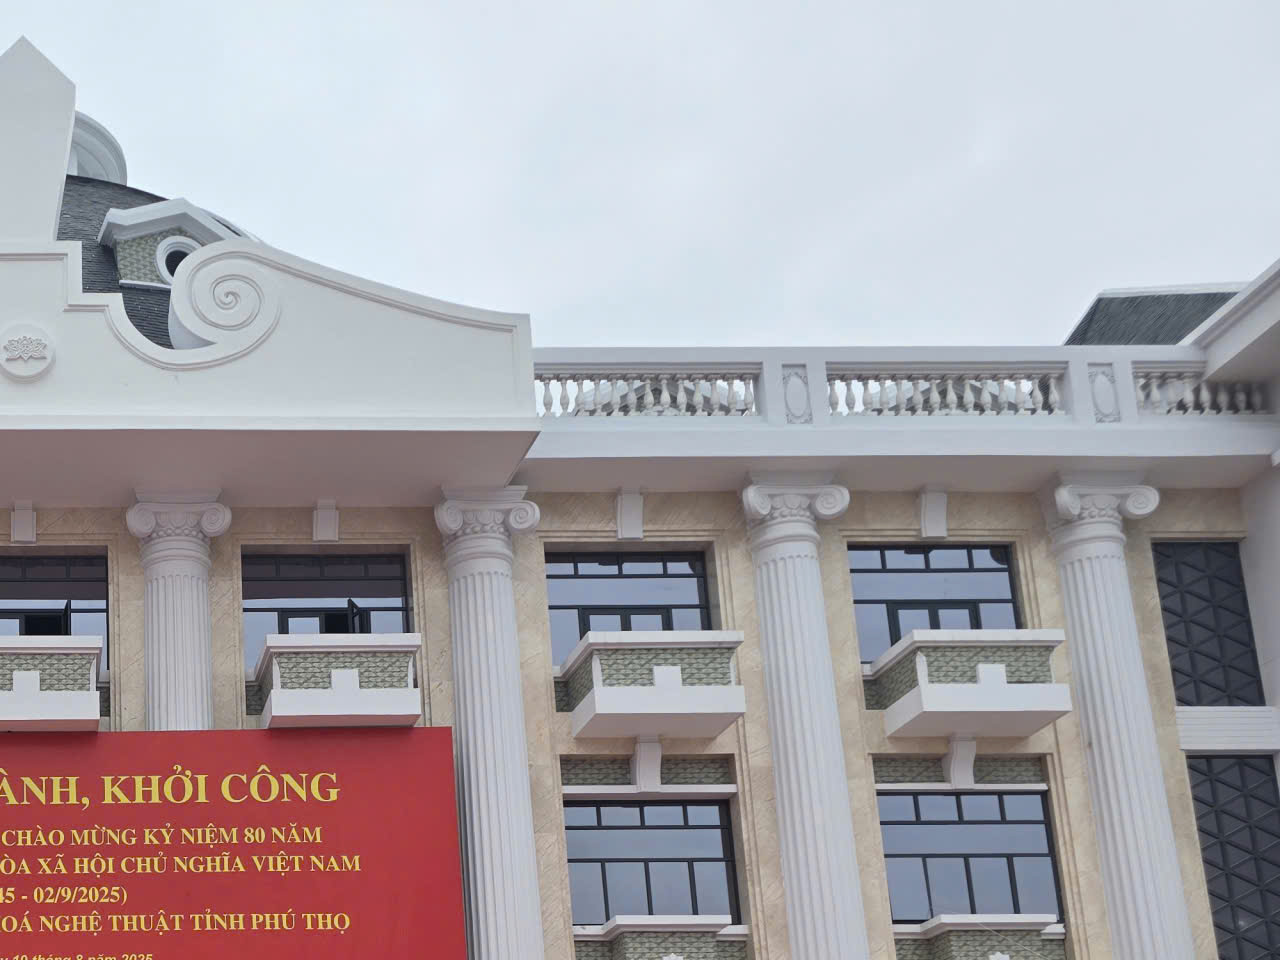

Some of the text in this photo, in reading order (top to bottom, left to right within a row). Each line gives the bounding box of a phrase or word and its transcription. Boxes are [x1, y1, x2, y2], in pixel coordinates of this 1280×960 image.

[100, 764, 210, 804] KHỞI
[220, 764, 341, 803] CÔNG
[1, 824, 65, 847] CHÀO
[69, 823, 138, 846] MỪNG
[143, 822, 175, 845] KỶ
[180, 822, 239, 849] NIỆM
[243, 826, 266, 844] 80
[270, 822, 323, 844] NĂM
[37, 853, 68, 875] XÃ
[73, 852, 116, 879] HỘI
[120, 850, 168, 874] CHỦ
[172, 851, 246, 873] NGHĨA
[251, 850, 304, 877] VIỆT
[309, 854, 362, 872] NAM
[33, 886, 128, 906] 02/9/2025)
[39, 909, 103, 937] NGHỆ
[107, 909, 185, 936] THUẬT
[189, 908, 246, 931] TỈNH
[250, 908, 297, 930] PHÚ
[301, 912, 351, 935] THỌ
